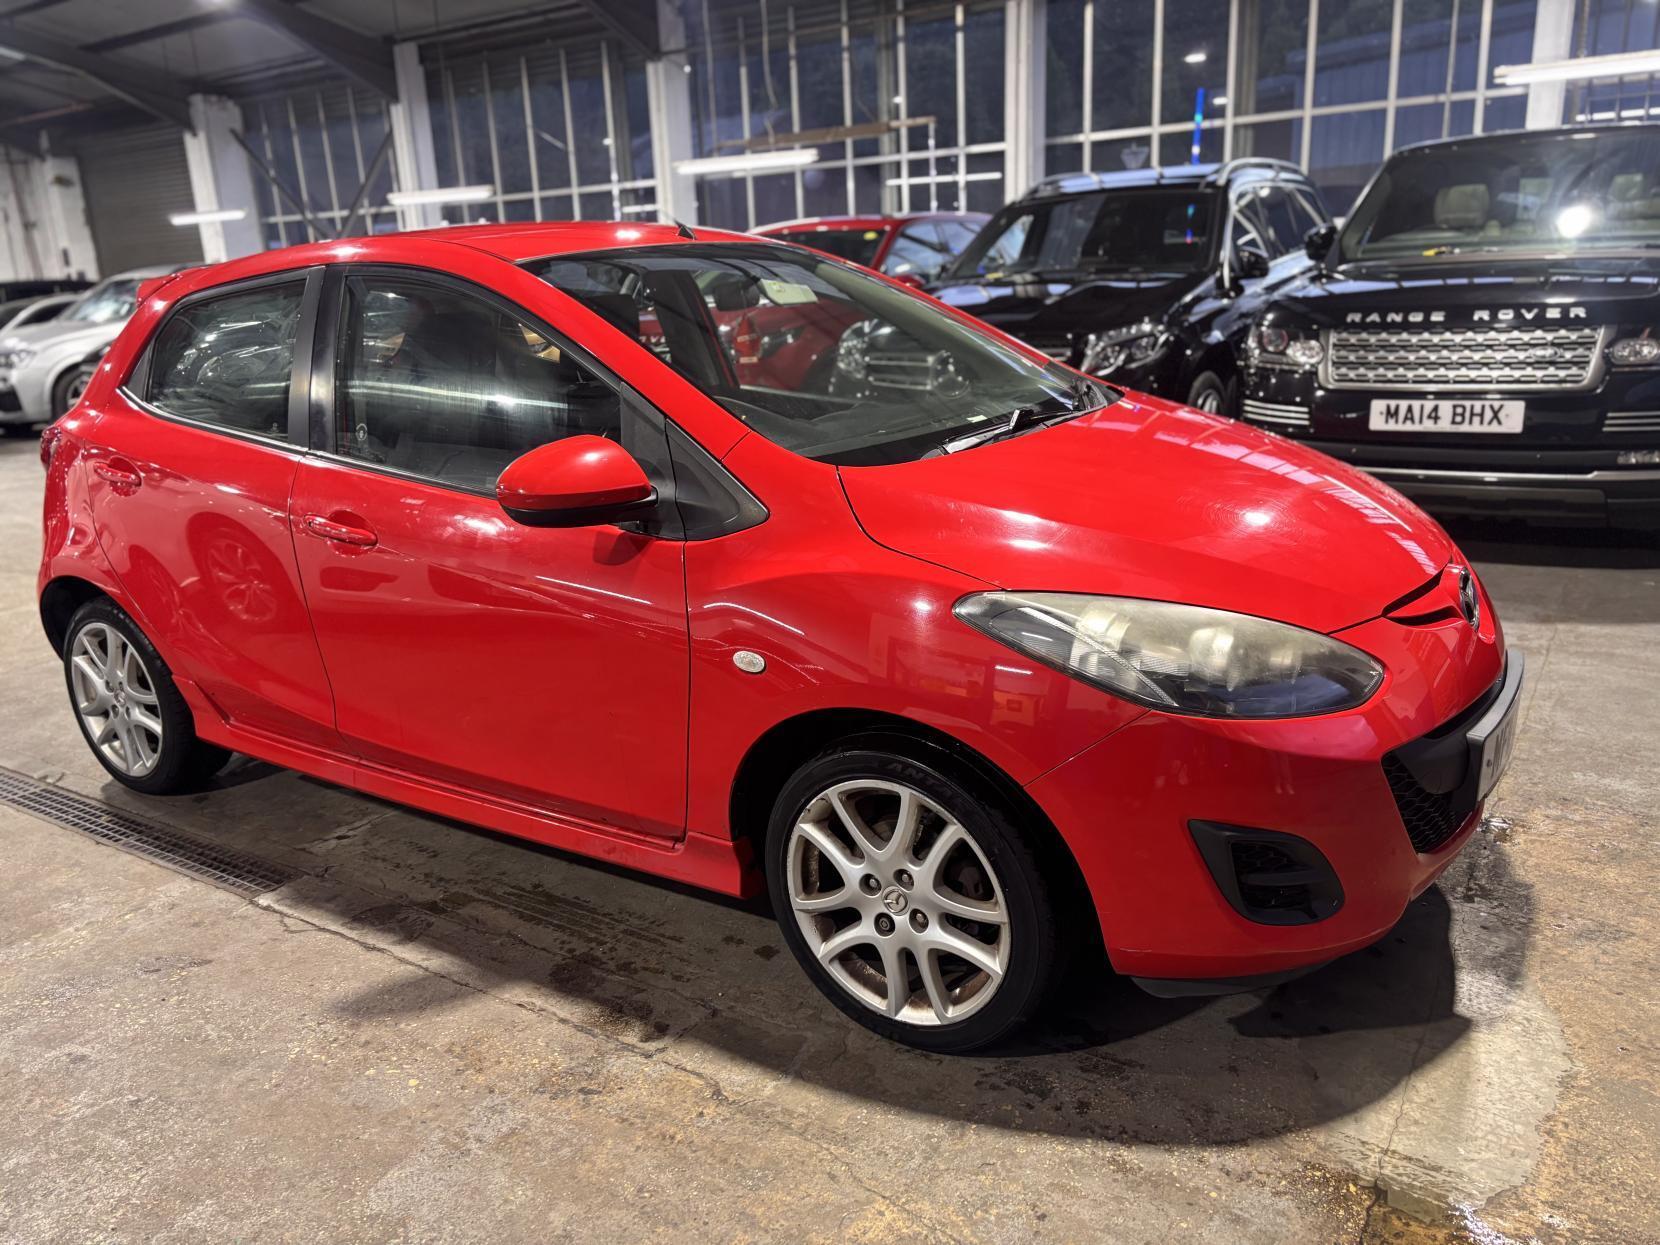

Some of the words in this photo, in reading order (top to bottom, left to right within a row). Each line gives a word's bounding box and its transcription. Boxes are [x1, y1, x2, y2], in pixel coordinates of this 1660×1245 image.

[1346, 311, 1446, 323] RANGE
[1473, 307, 1586, 321] ROVER
[1384, 403, 1441, 425] MA14
[1450, 403, 1504, 426] BHX
